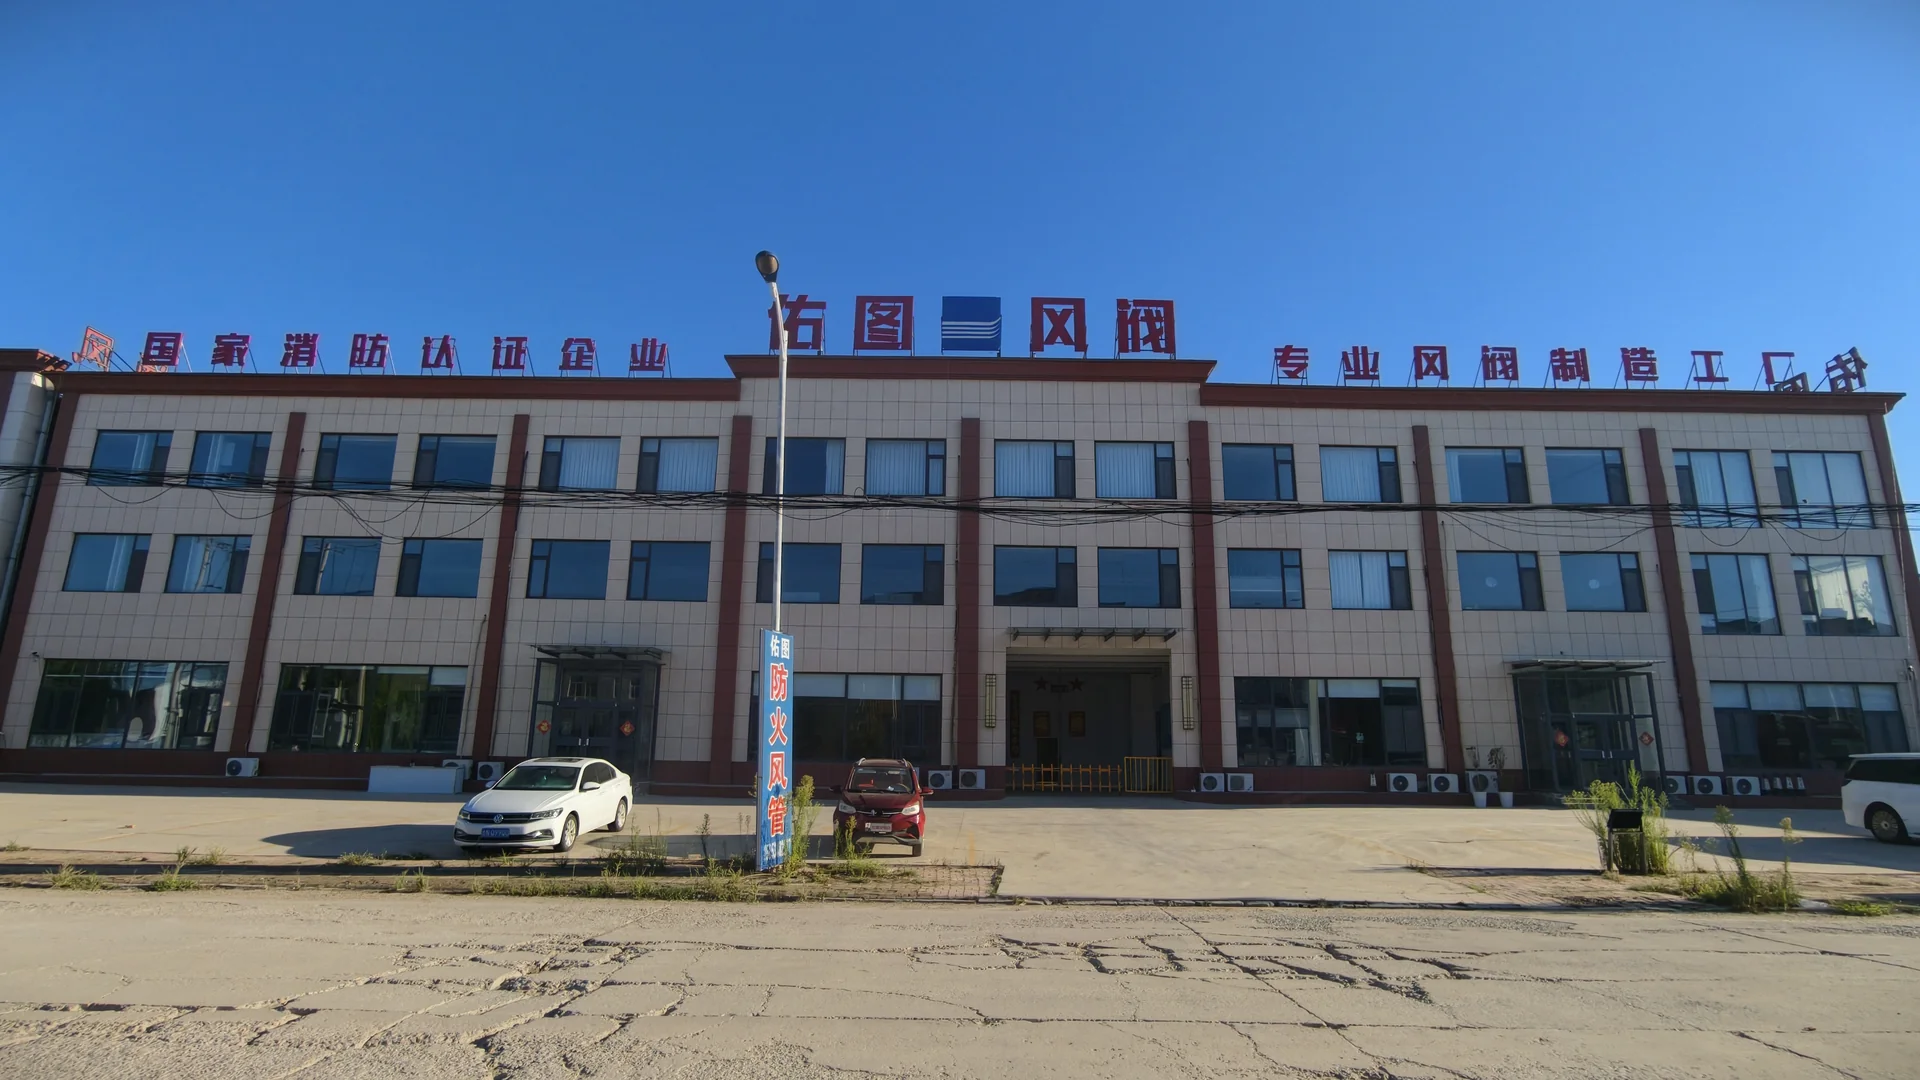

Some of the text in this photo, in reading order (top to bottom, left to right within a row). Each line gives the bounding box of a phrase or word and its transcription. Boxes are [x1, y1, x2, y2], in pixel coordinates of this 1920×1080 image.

[141, 331, 667, 371] 国家消防认证企业
[1273, 345, 1795, 385] 专业风阀制造工厂
[770, 634, 790, 659] 佑图
[768, 663, 789, 837] 防火风管
